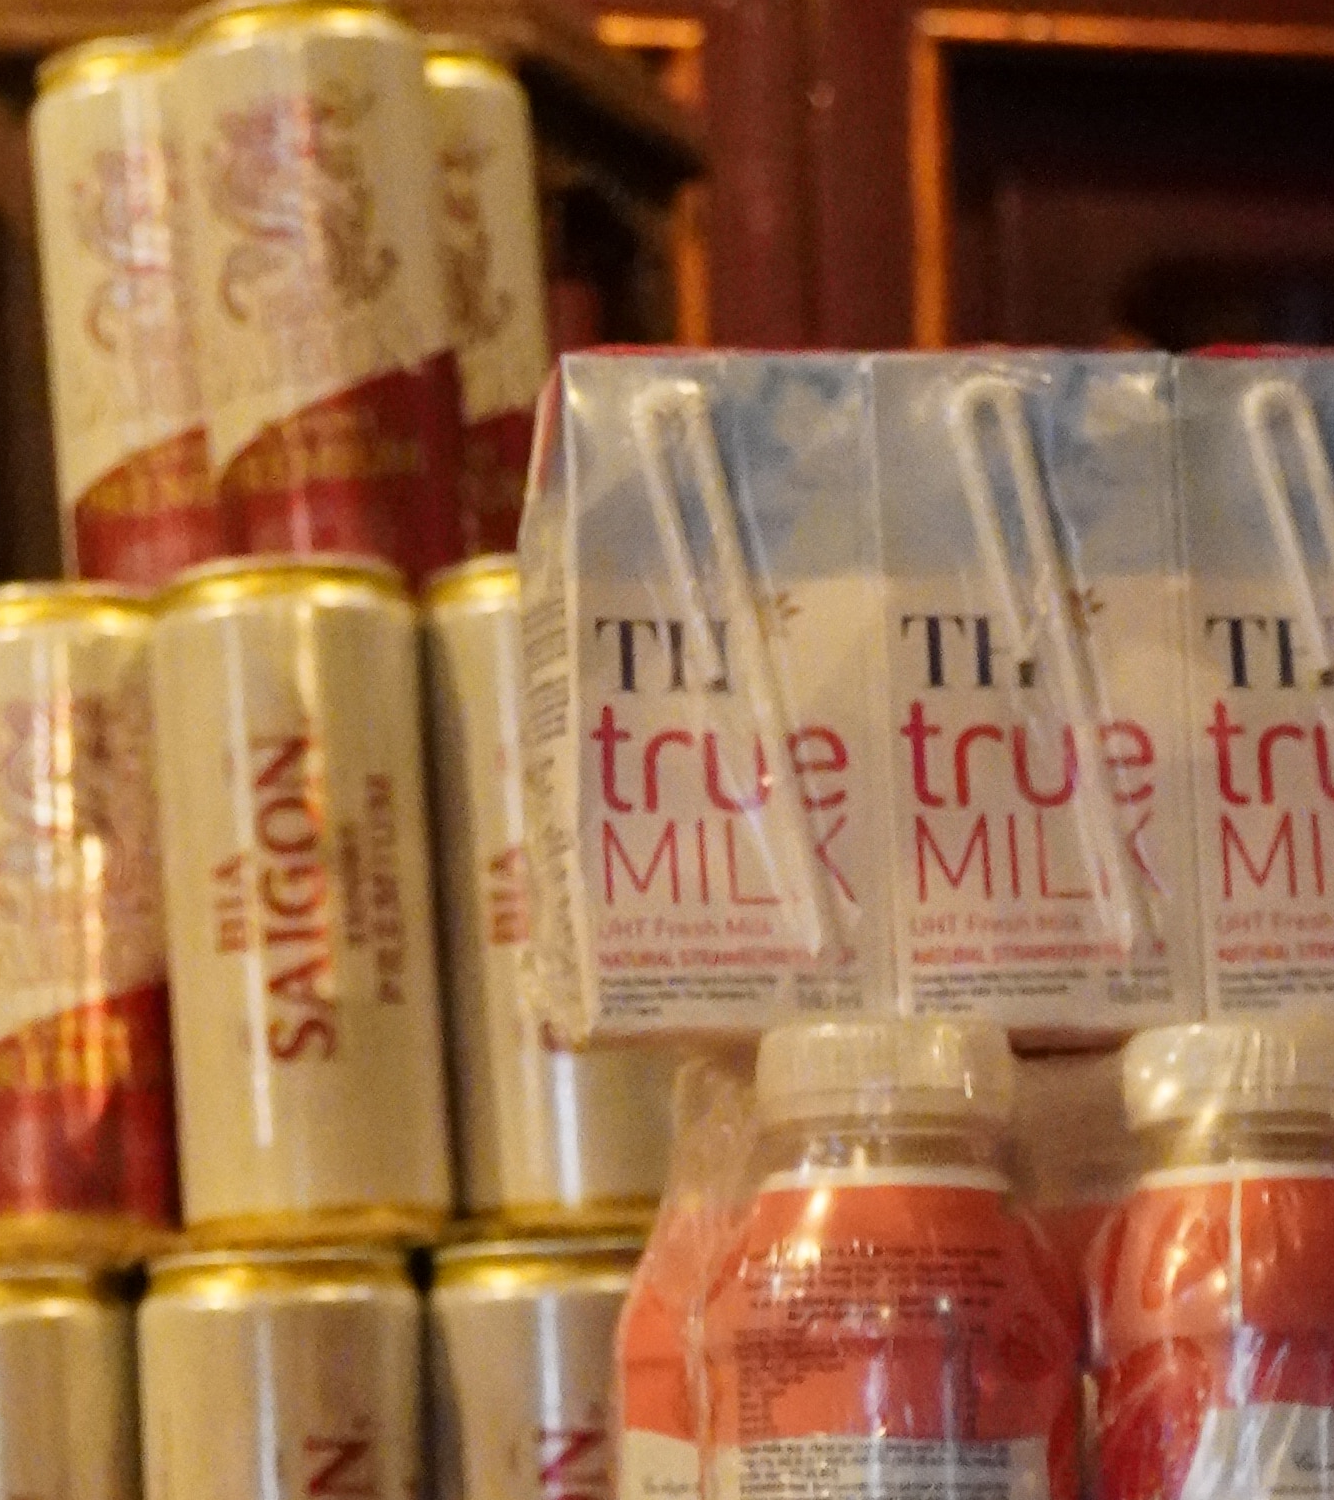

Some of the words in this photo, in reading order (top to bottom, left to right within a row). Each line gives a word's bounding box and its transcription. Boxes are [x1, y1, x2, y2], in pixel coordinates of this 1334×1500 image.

[591, 705, 849, 814] true
[900, 701, 1156, 807] true
[252, 728, 339, 1065] SAIGON
